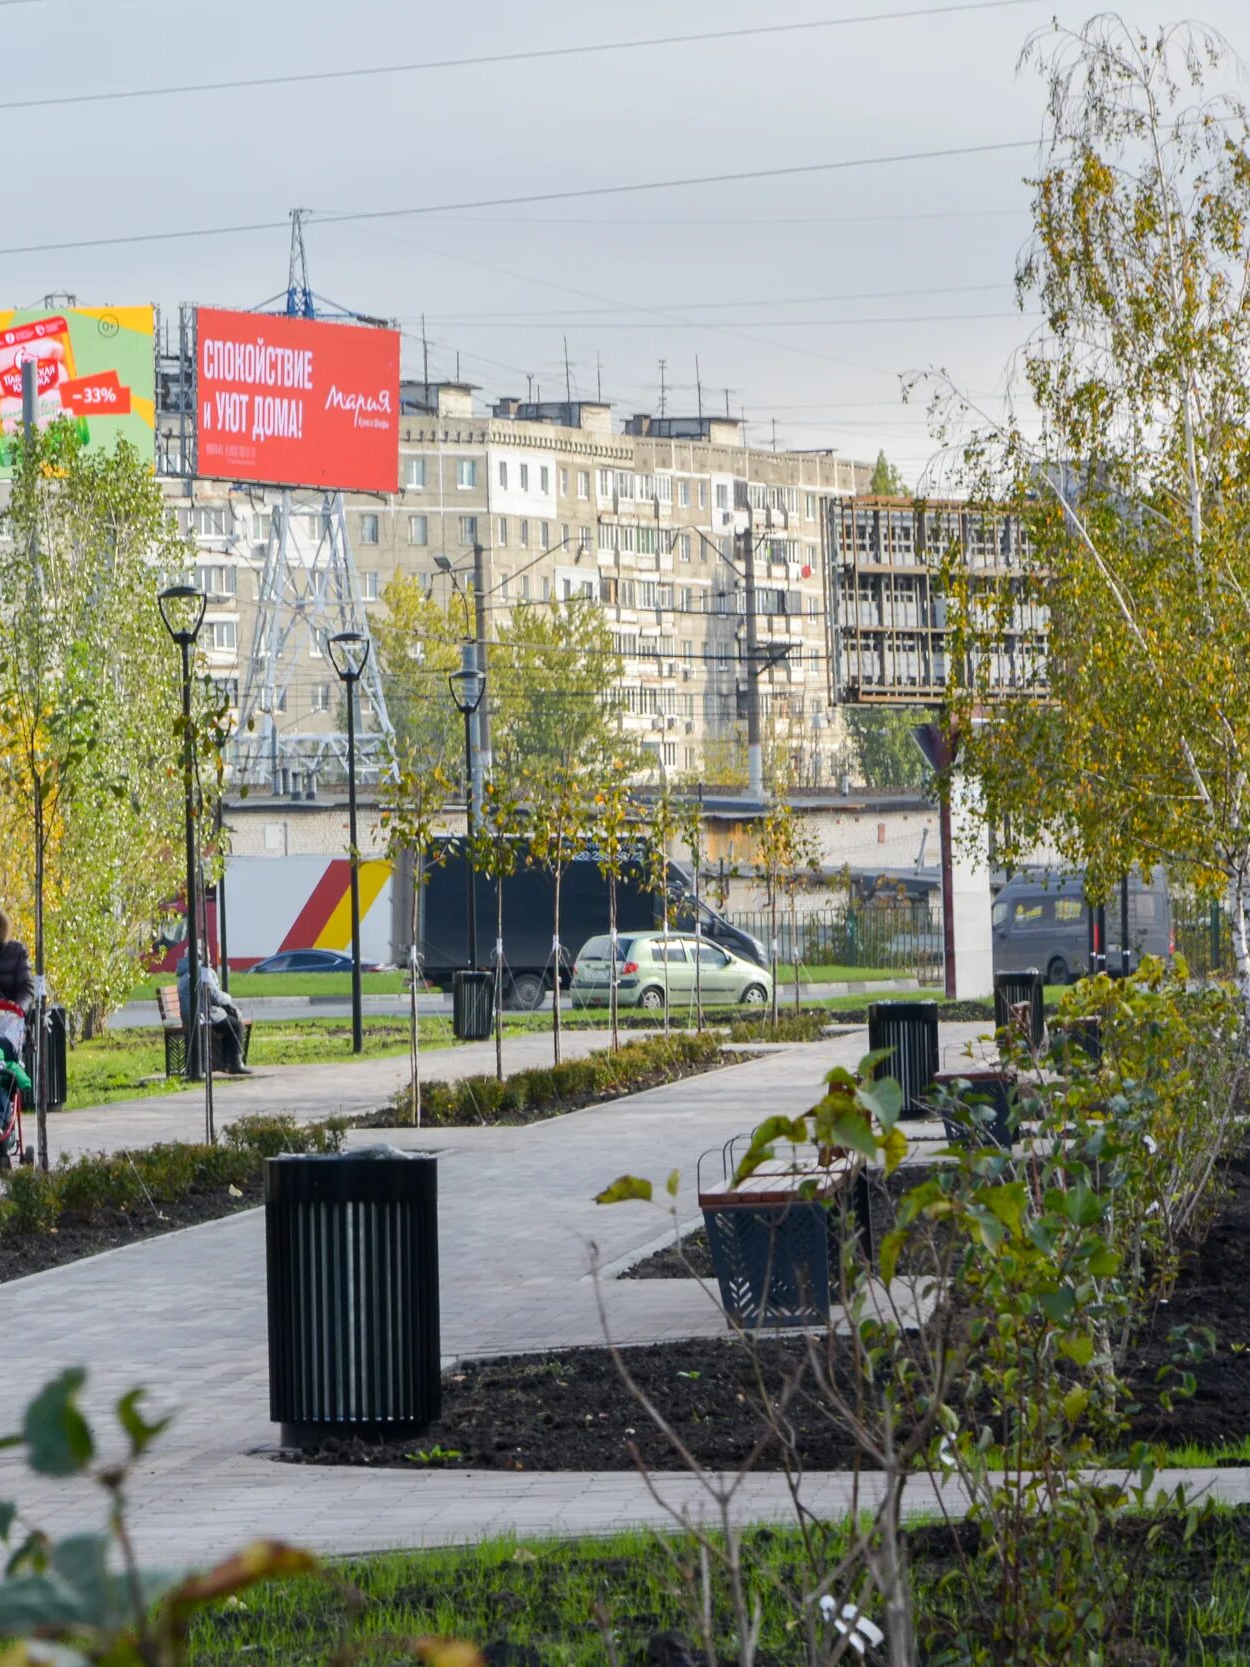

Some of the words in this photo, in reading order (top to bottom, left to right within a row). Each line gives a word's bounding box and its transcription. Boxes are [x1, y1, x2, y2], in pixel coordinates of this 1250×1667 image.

[203, 337, 314, 390] СПОКОЙСТВИЕ
[72, 386, 117, 404] -33%
[203, 401, 211, 429] и
[216, 391, 249, 433] УЮТ
[252, 395, 303, 443] ДОМА!
